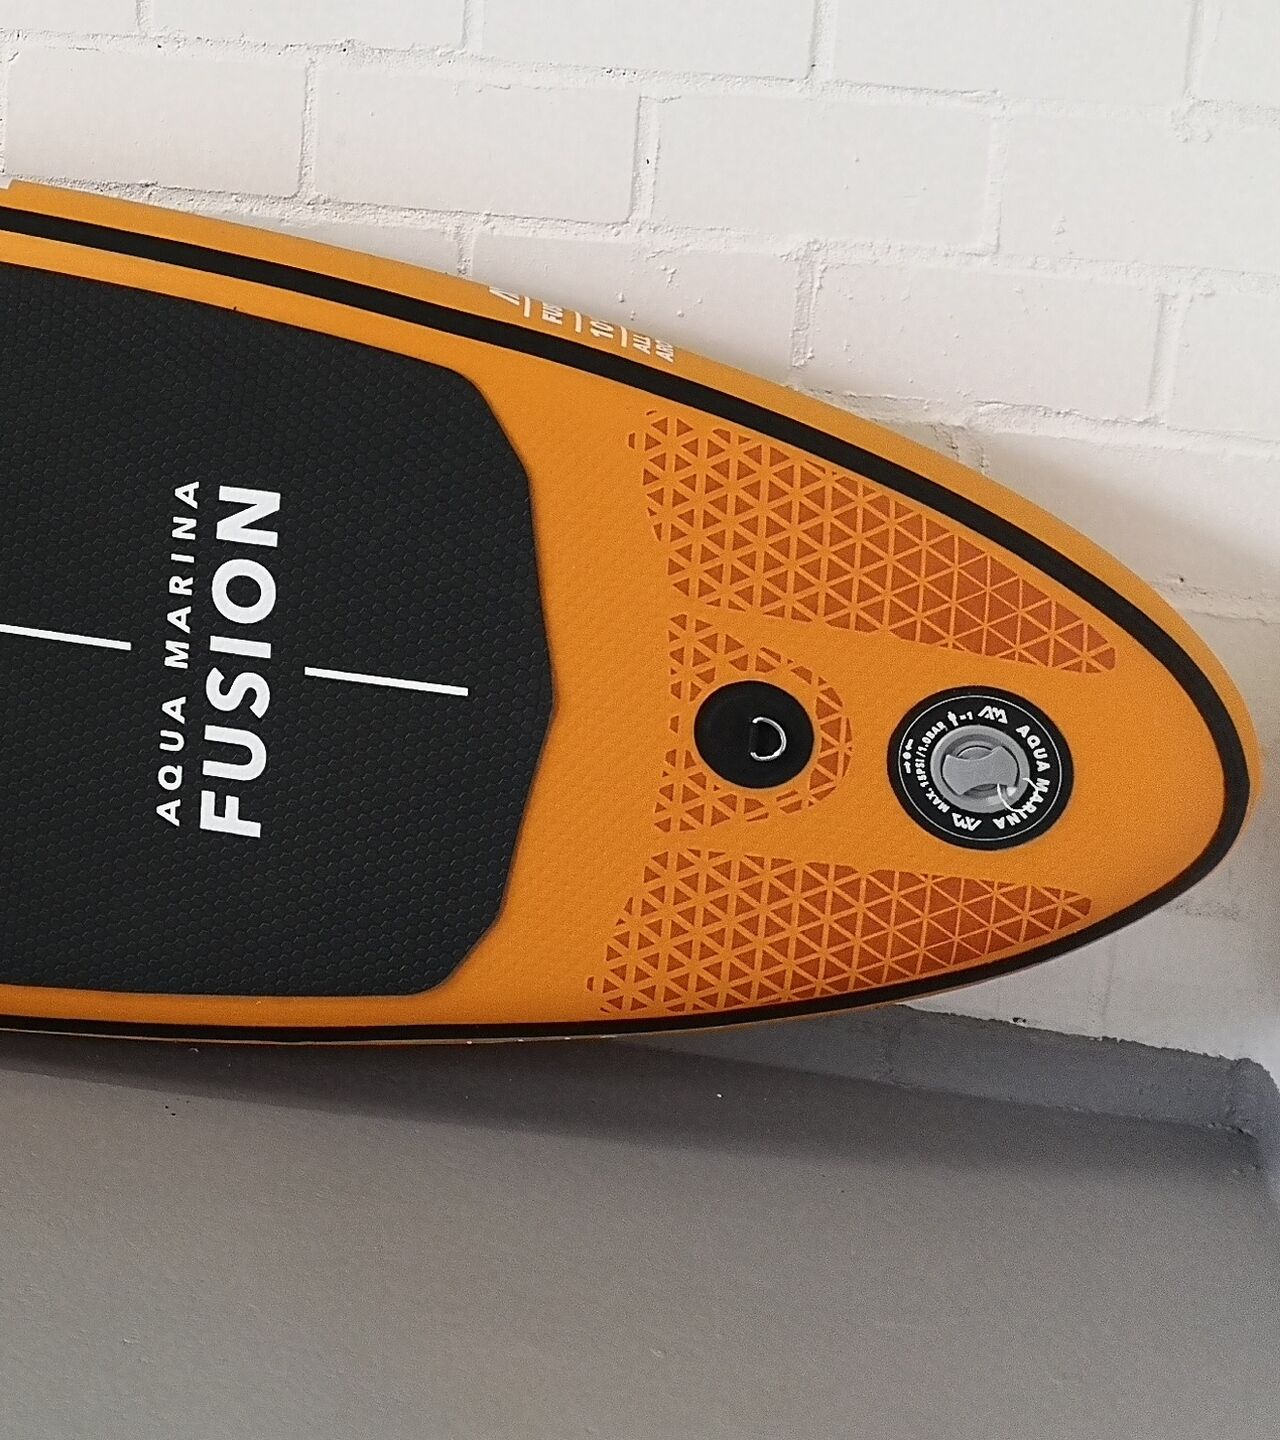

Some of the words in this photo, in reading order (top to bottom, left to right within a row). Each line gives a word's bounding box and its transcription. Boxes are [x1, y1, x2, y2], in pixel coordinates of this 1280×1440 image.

[164, 481, 200, 670] MARINA
[199, 484, 281, 839] FUSION
[156, 696, 186, 827] AQUA
[992, 777, 1051, 830] MARINA
[1016, 724, 1051, 772] AQUA
